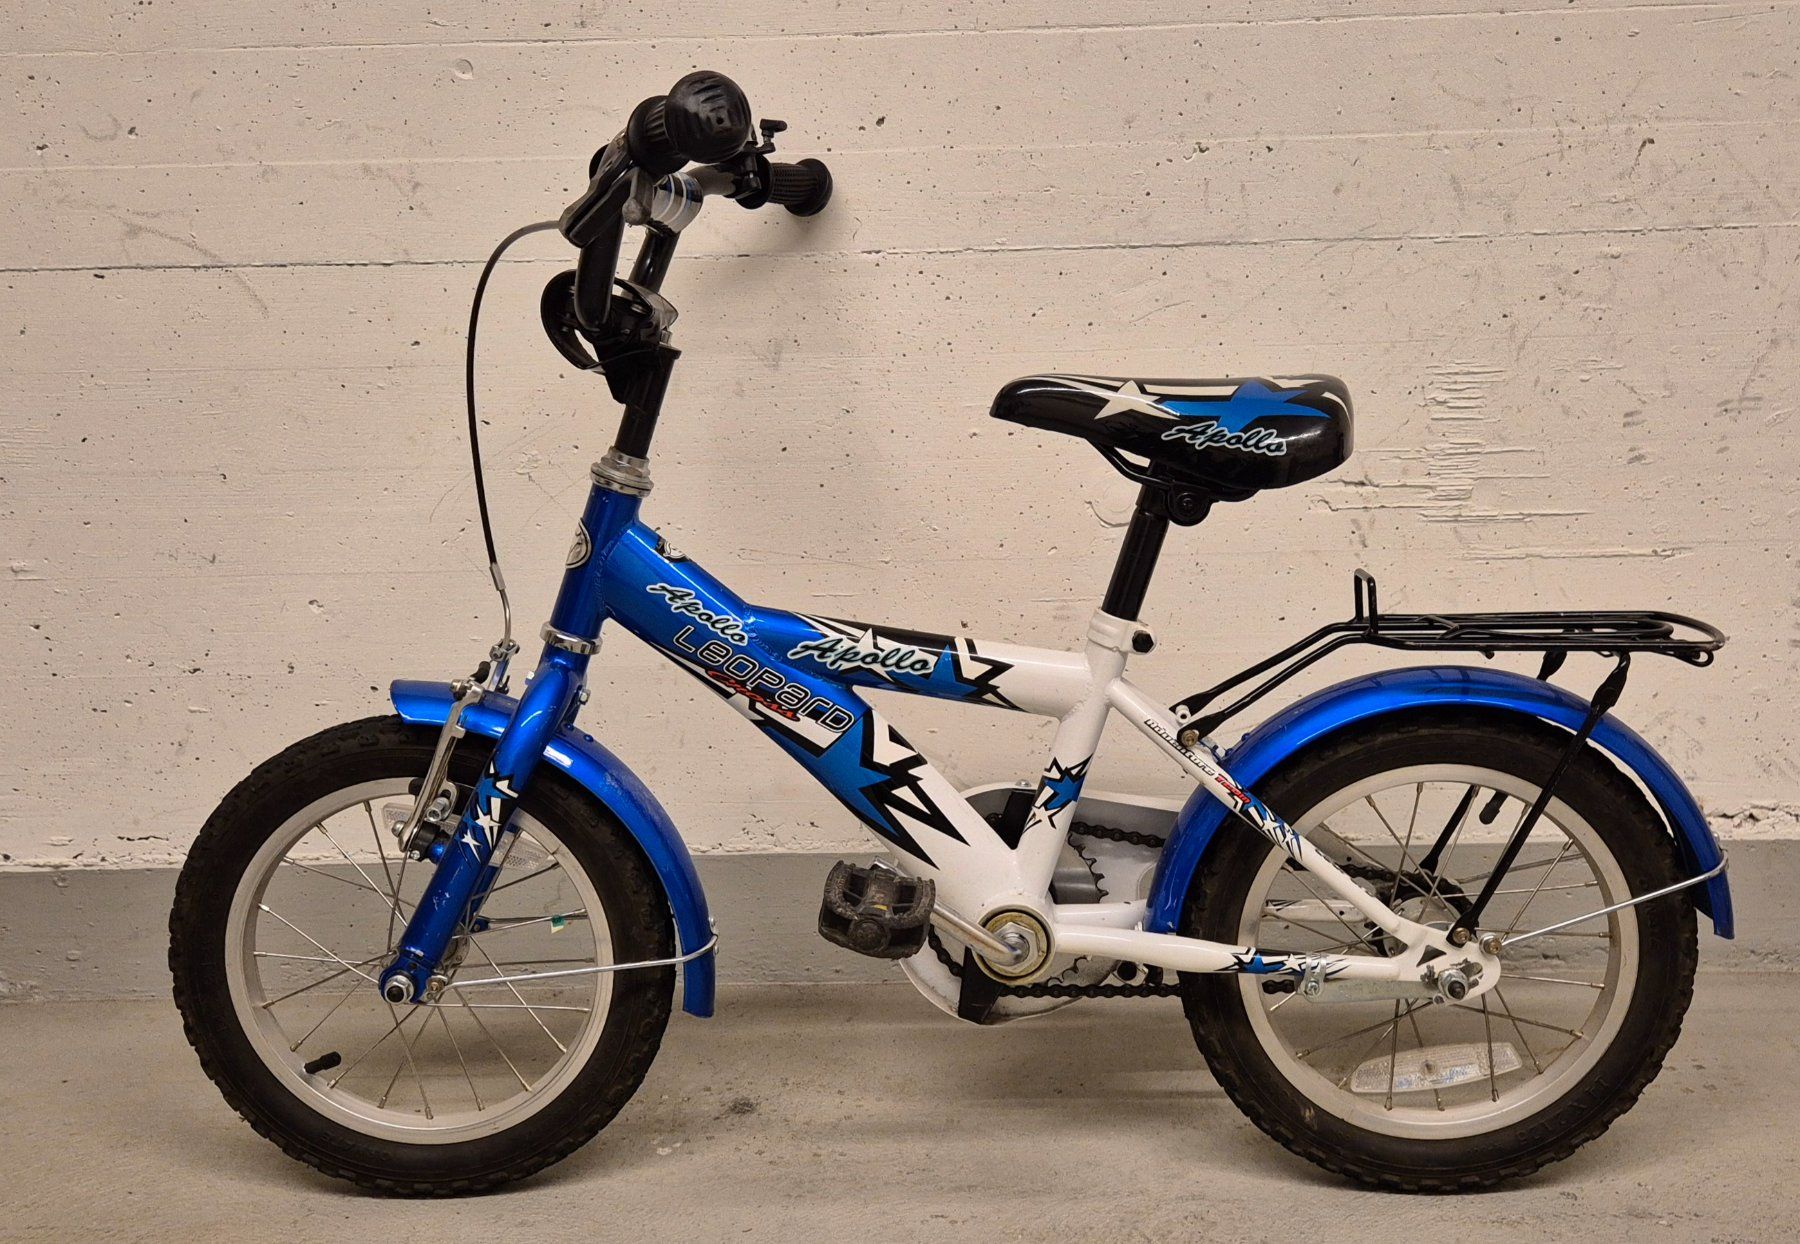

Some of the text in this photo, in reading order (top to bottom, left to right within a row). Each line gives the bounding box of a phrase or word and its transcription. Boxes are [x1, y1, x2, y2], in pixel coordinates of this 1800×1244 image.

[1161, 421, 1287, 456] Apollo
[646, 583, 748, 646] Apollo
[787, 637, 935, 674] Apollo
